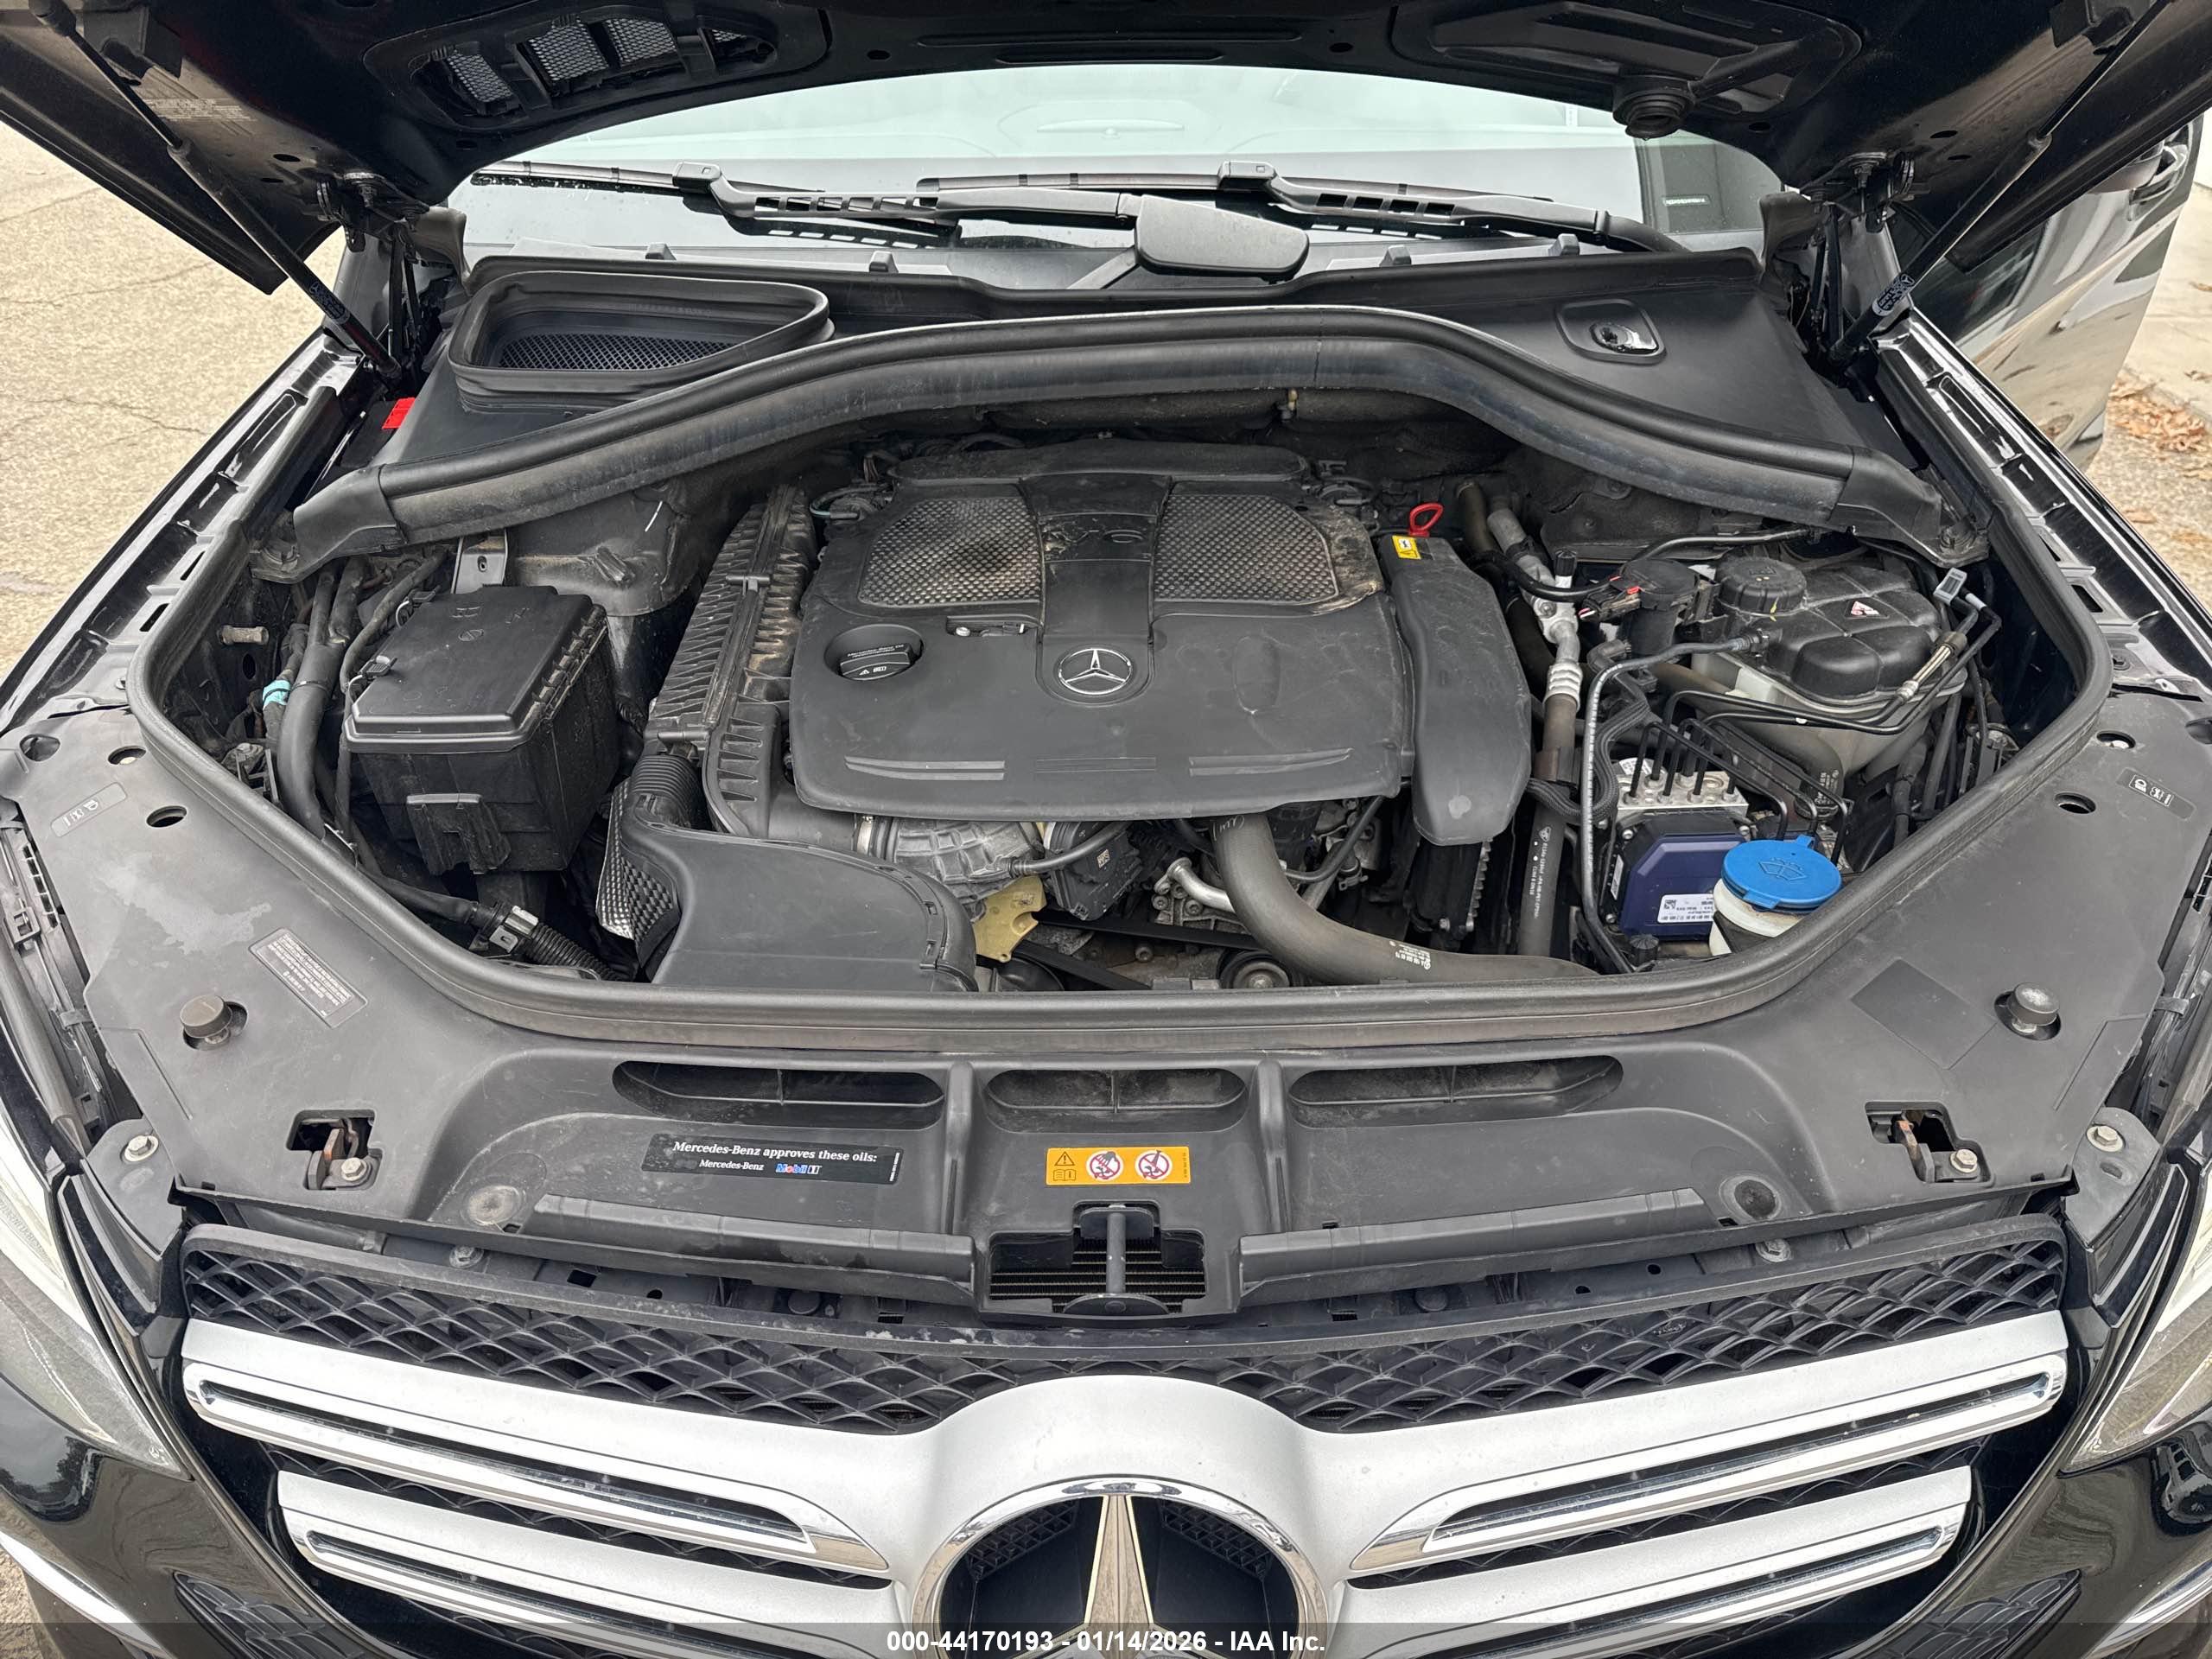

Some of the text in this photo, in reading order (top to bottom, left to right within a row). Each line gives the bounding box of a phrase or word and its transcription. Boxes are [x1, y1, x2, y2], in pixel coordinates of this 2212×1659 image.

[672, 1141, 877, 1163] Mercedes-Benz approves these oils:
[699, 1159, 764, 1171] Mercedes-Benz
[776, 1163, 808, 1174] Mobil
